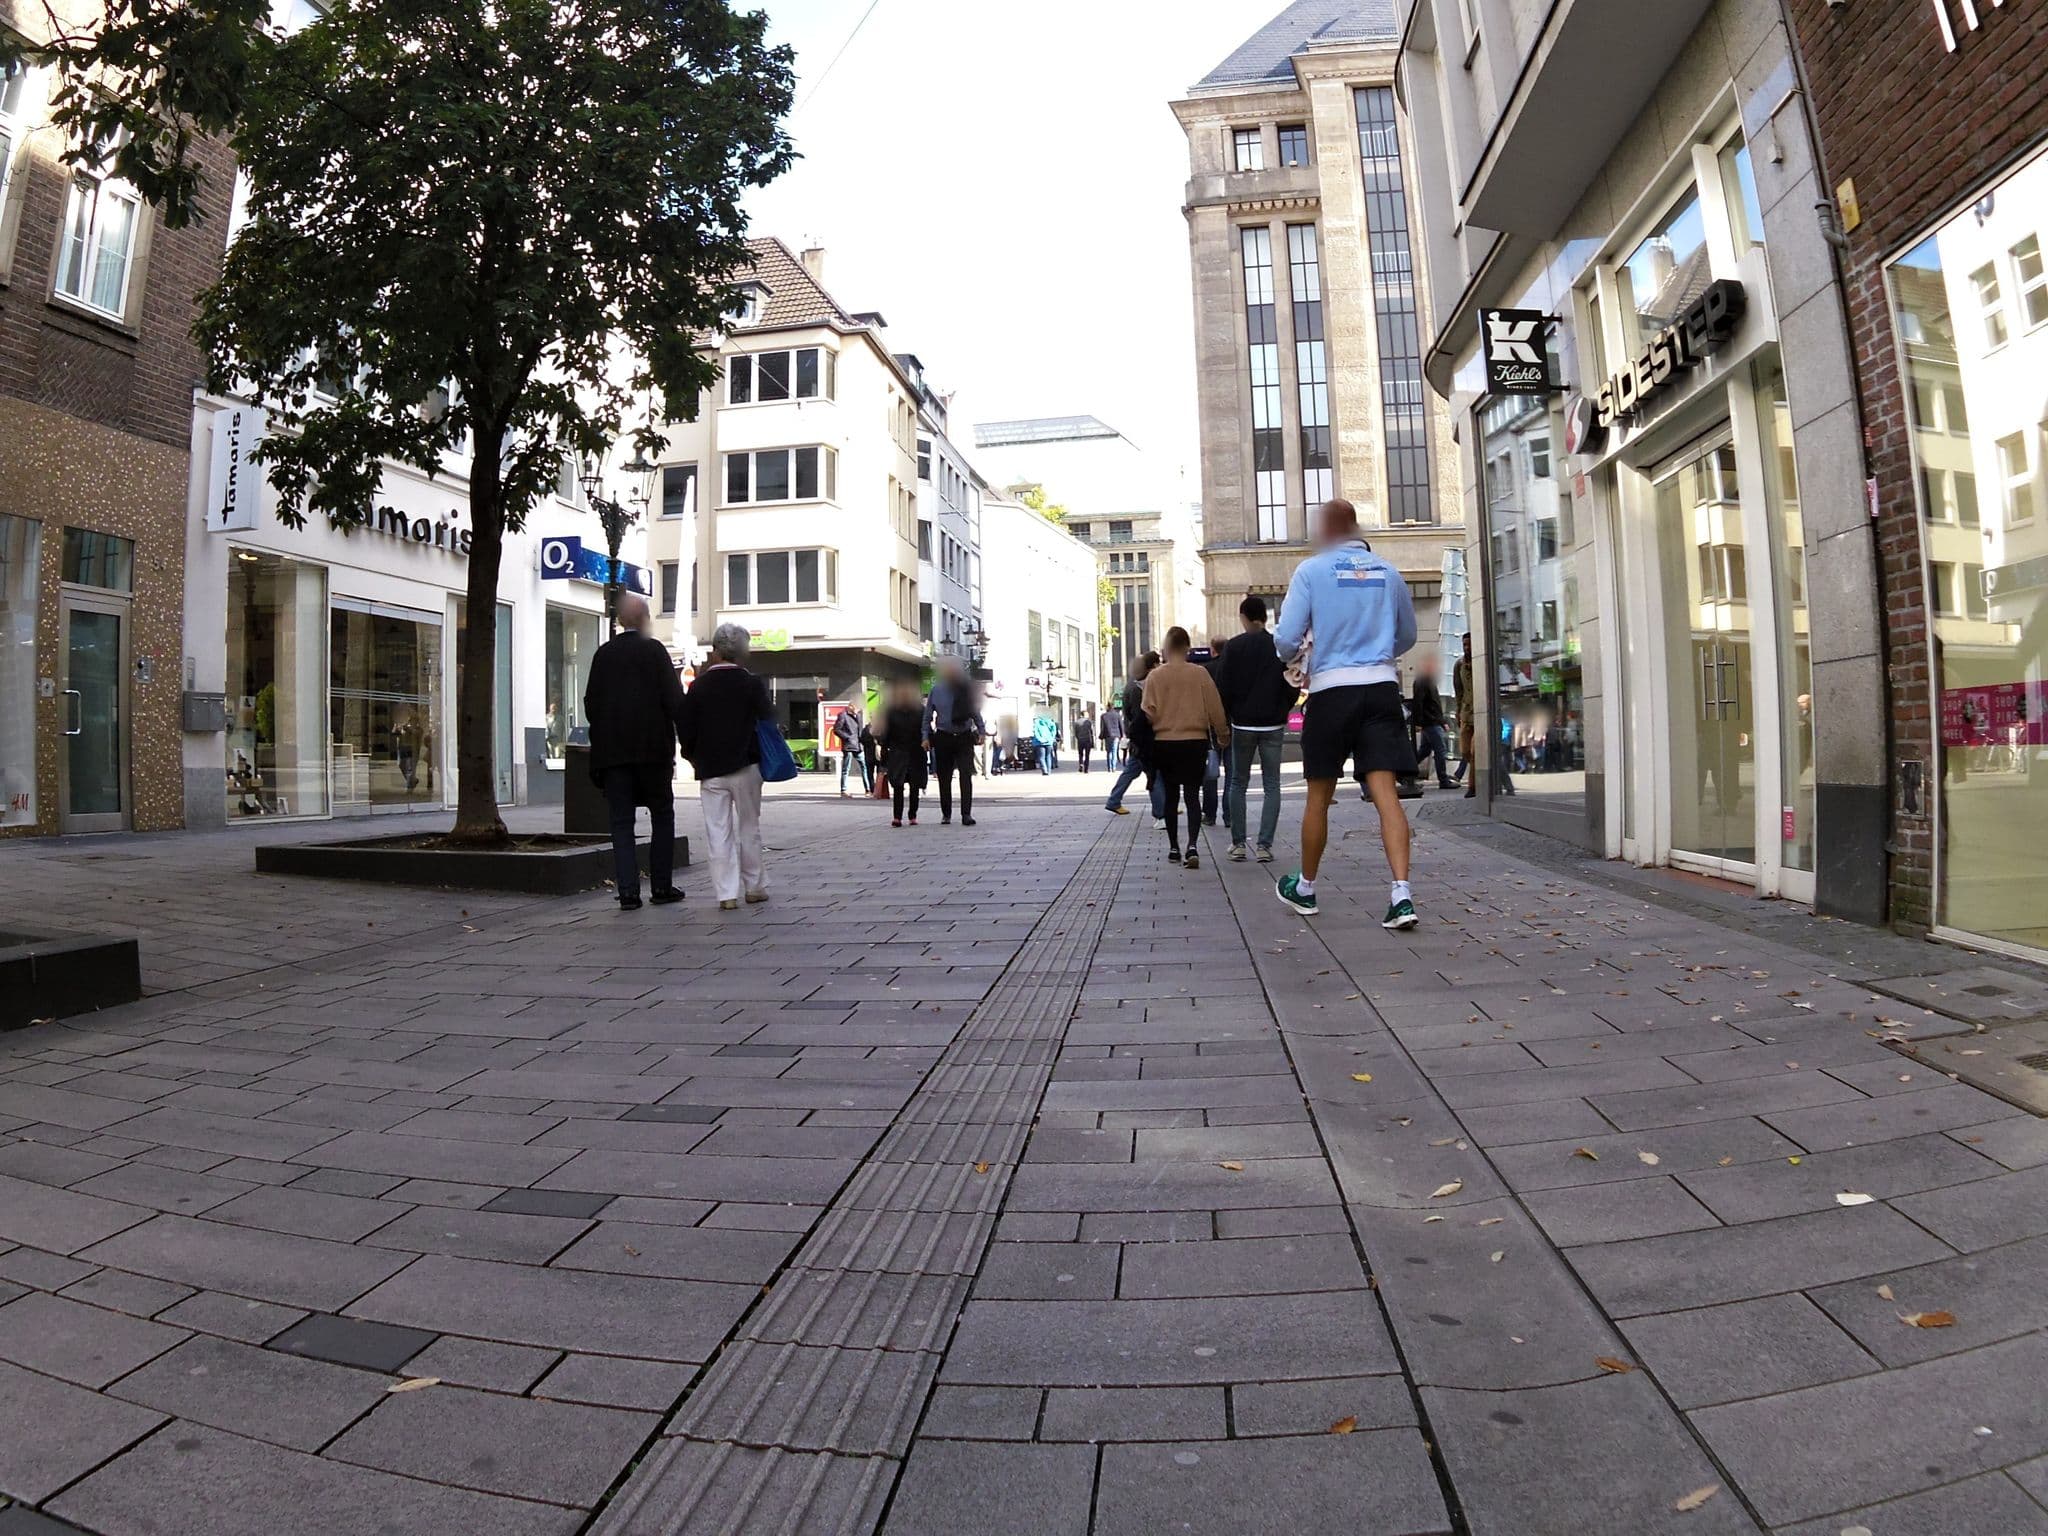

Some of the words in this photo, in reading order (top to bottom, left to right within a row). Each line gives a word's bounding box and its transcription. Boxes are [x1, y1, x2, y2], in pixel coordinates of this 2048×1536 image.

[1486, 311, 1543, 363] K
[1494, 364, 1542, 381] Kiehl's
[1597, 279, 1745, 428] SIDESTEP
[222, 411, 241, 525] tamaris
